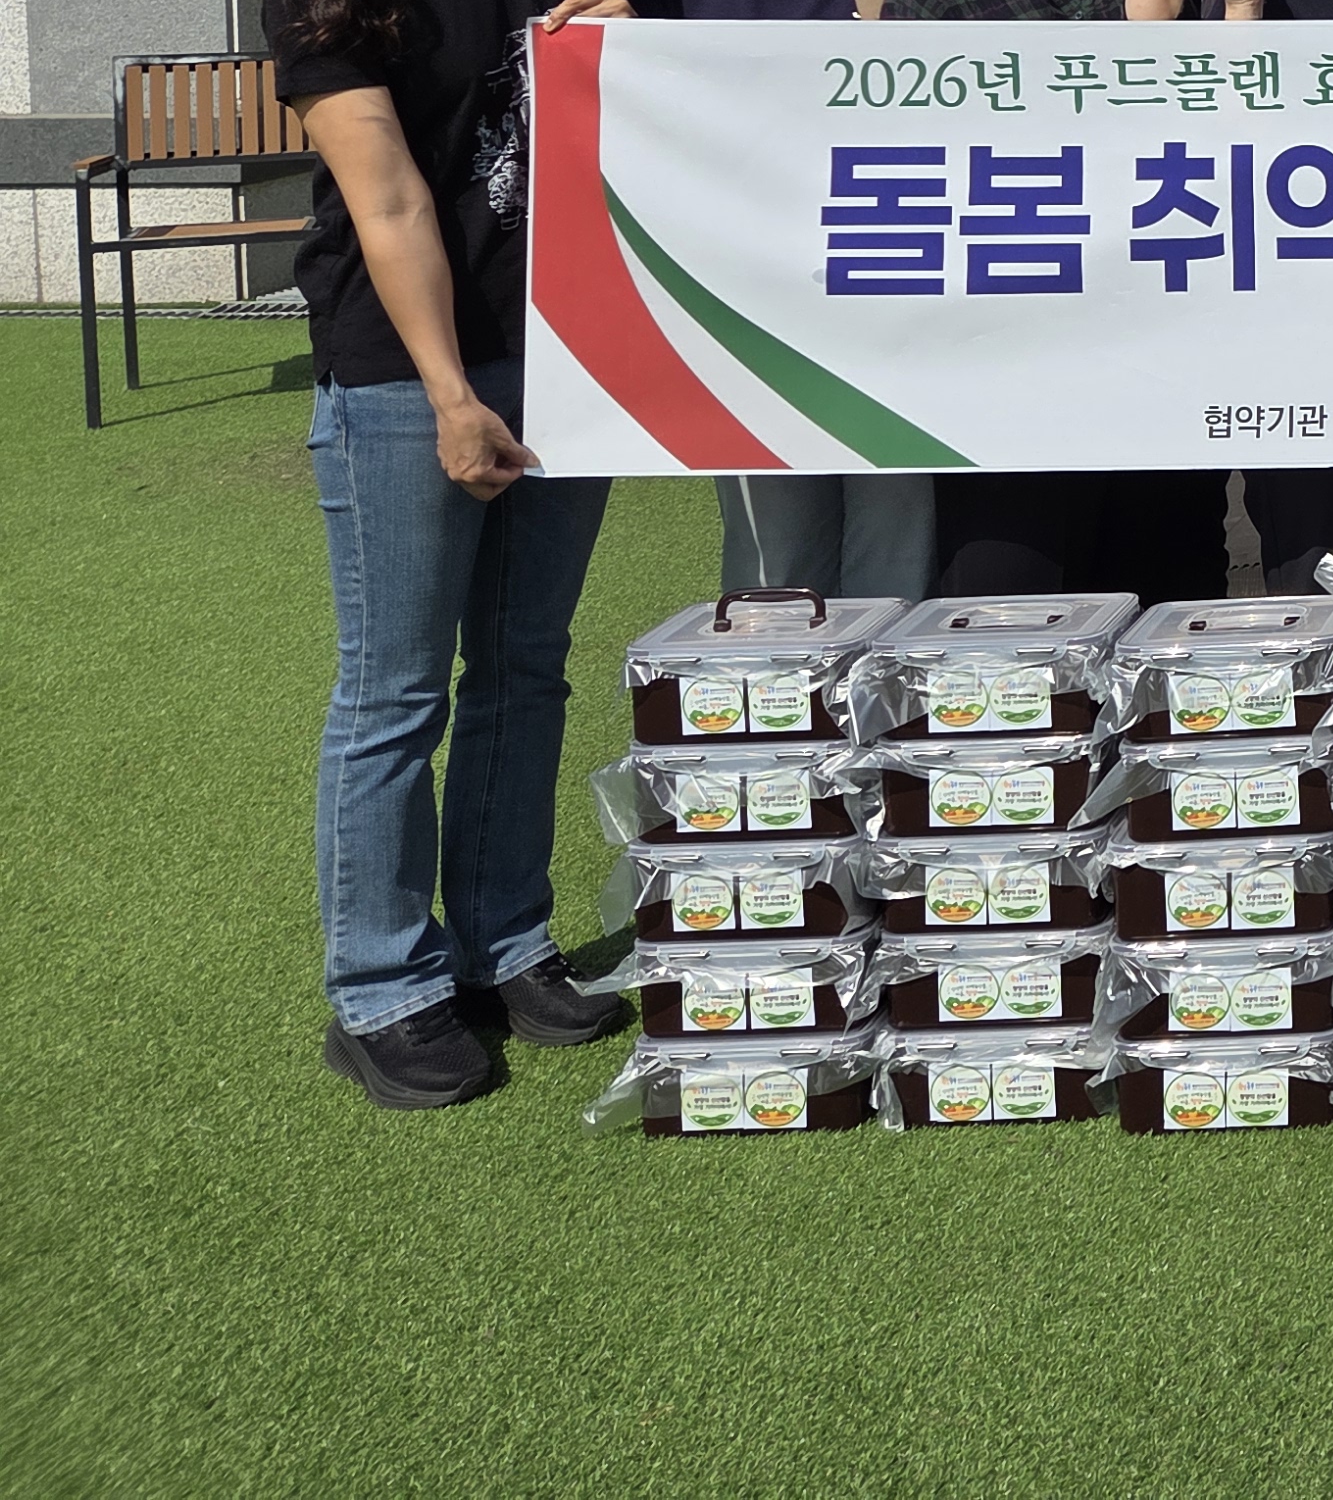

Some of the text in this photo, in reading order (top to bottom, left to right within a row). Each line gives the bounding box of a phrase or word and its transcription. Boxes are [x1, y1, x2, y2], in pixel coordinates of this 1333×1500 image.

[824, 51, 1027, 112] 2026년
[1046, 50, 1285, 113] 푸드플랜
[820, 145, 1091, 296] 돌봄
[1204, 404, 1329, 439] 협약기관
